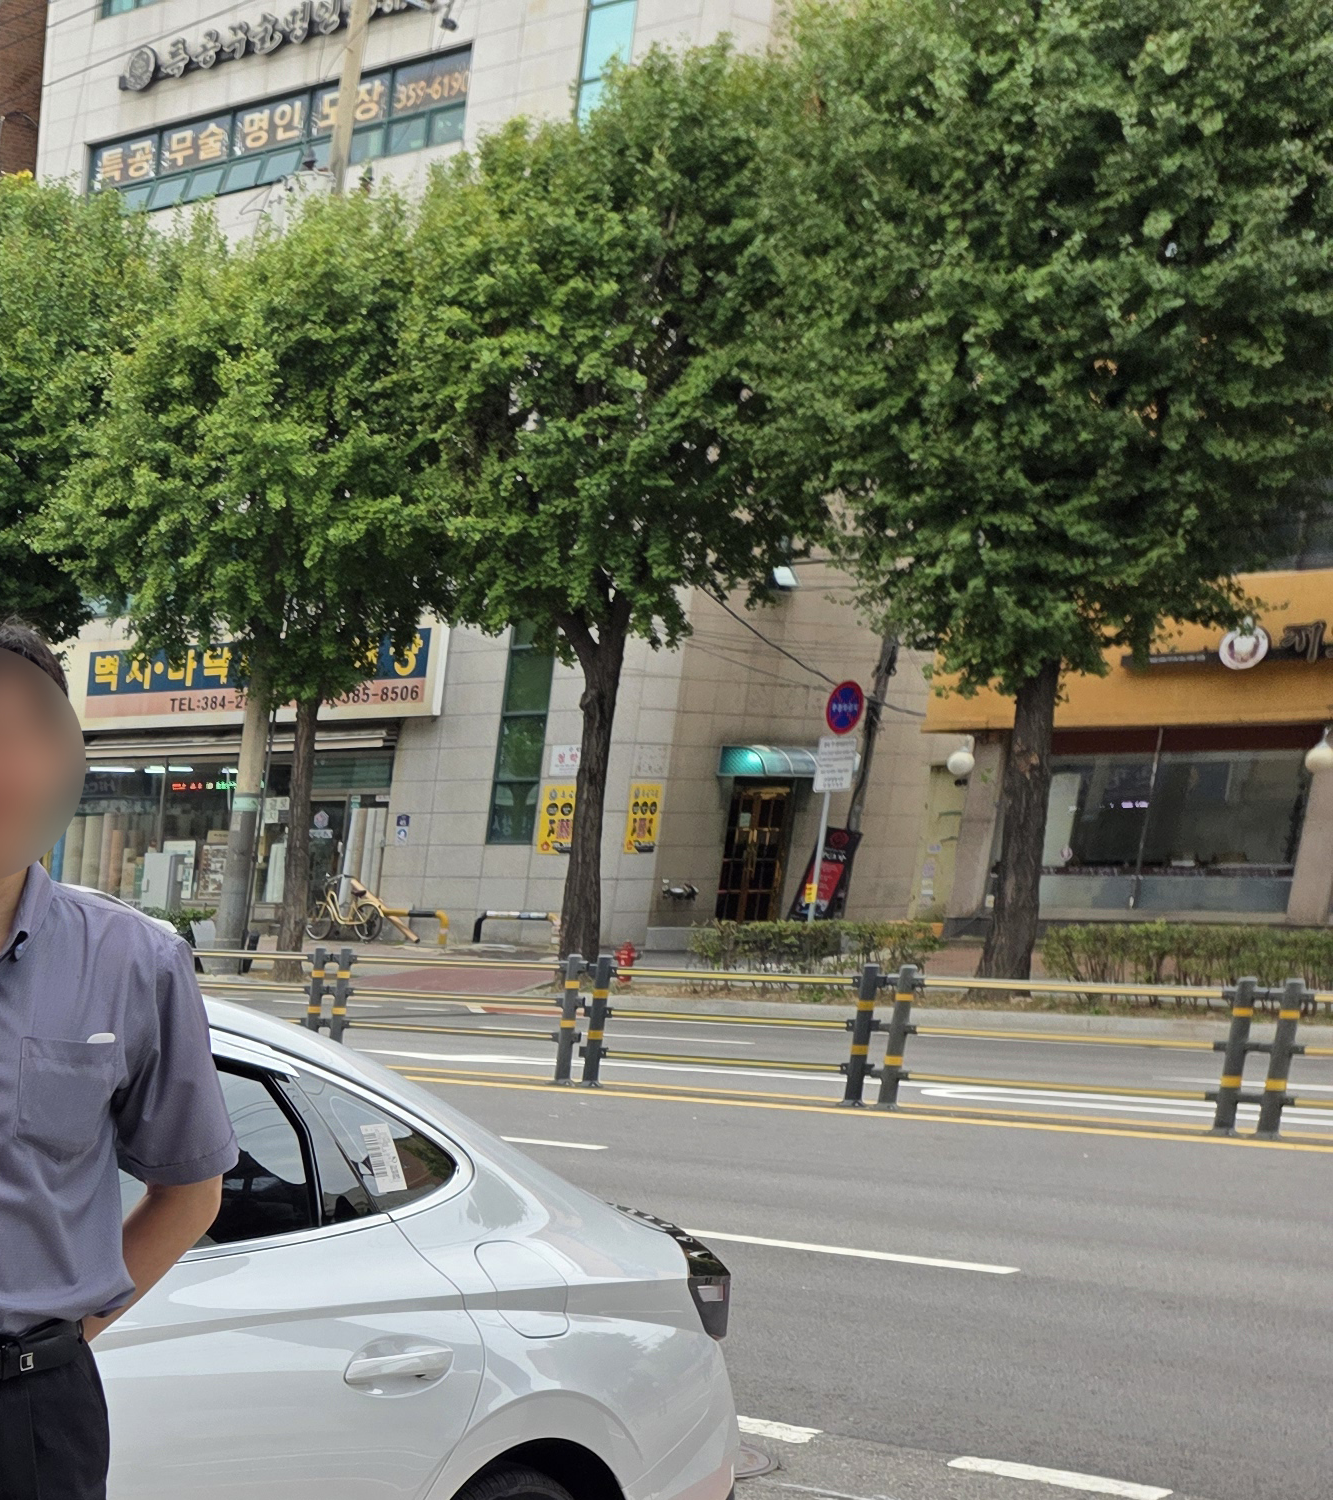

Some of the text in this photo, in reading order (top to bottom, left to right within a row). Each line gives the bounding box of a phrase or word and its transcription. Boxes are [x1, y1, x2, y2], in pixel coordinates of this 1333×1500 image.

[99, 140, 154, 183] 특공
[166, 122, 229, 166] 무술
[243, 100, 303, 149] 명인
